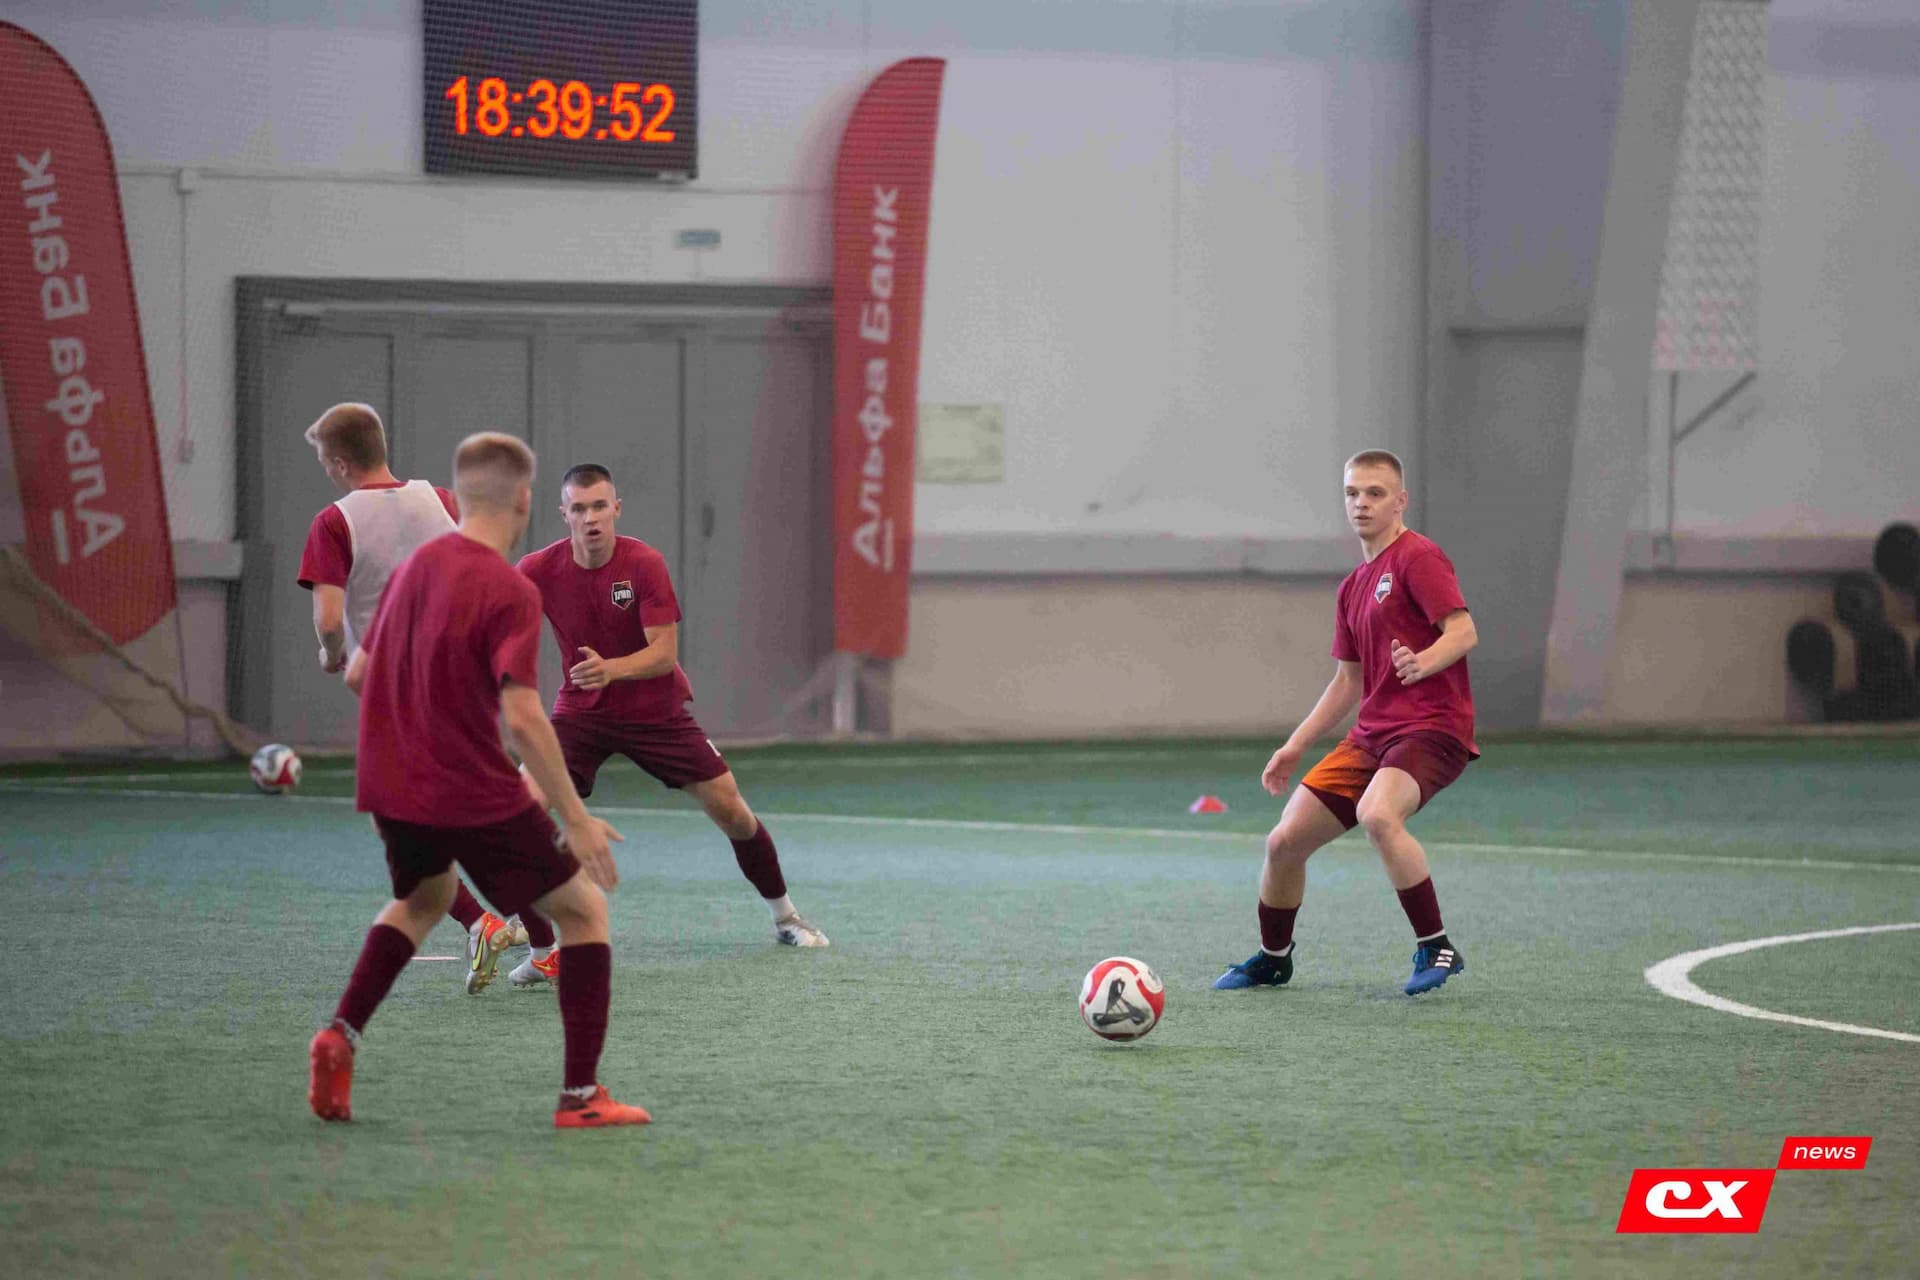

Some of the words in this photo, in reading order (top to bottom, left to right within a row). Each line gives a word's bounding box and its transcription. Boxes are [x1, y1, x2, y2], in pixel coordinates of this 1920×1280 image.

[446, 76, 676, 142] 18:39:52
[860, 184, 898, 344] Банк
[852, 358, 894, 572] Альфа
